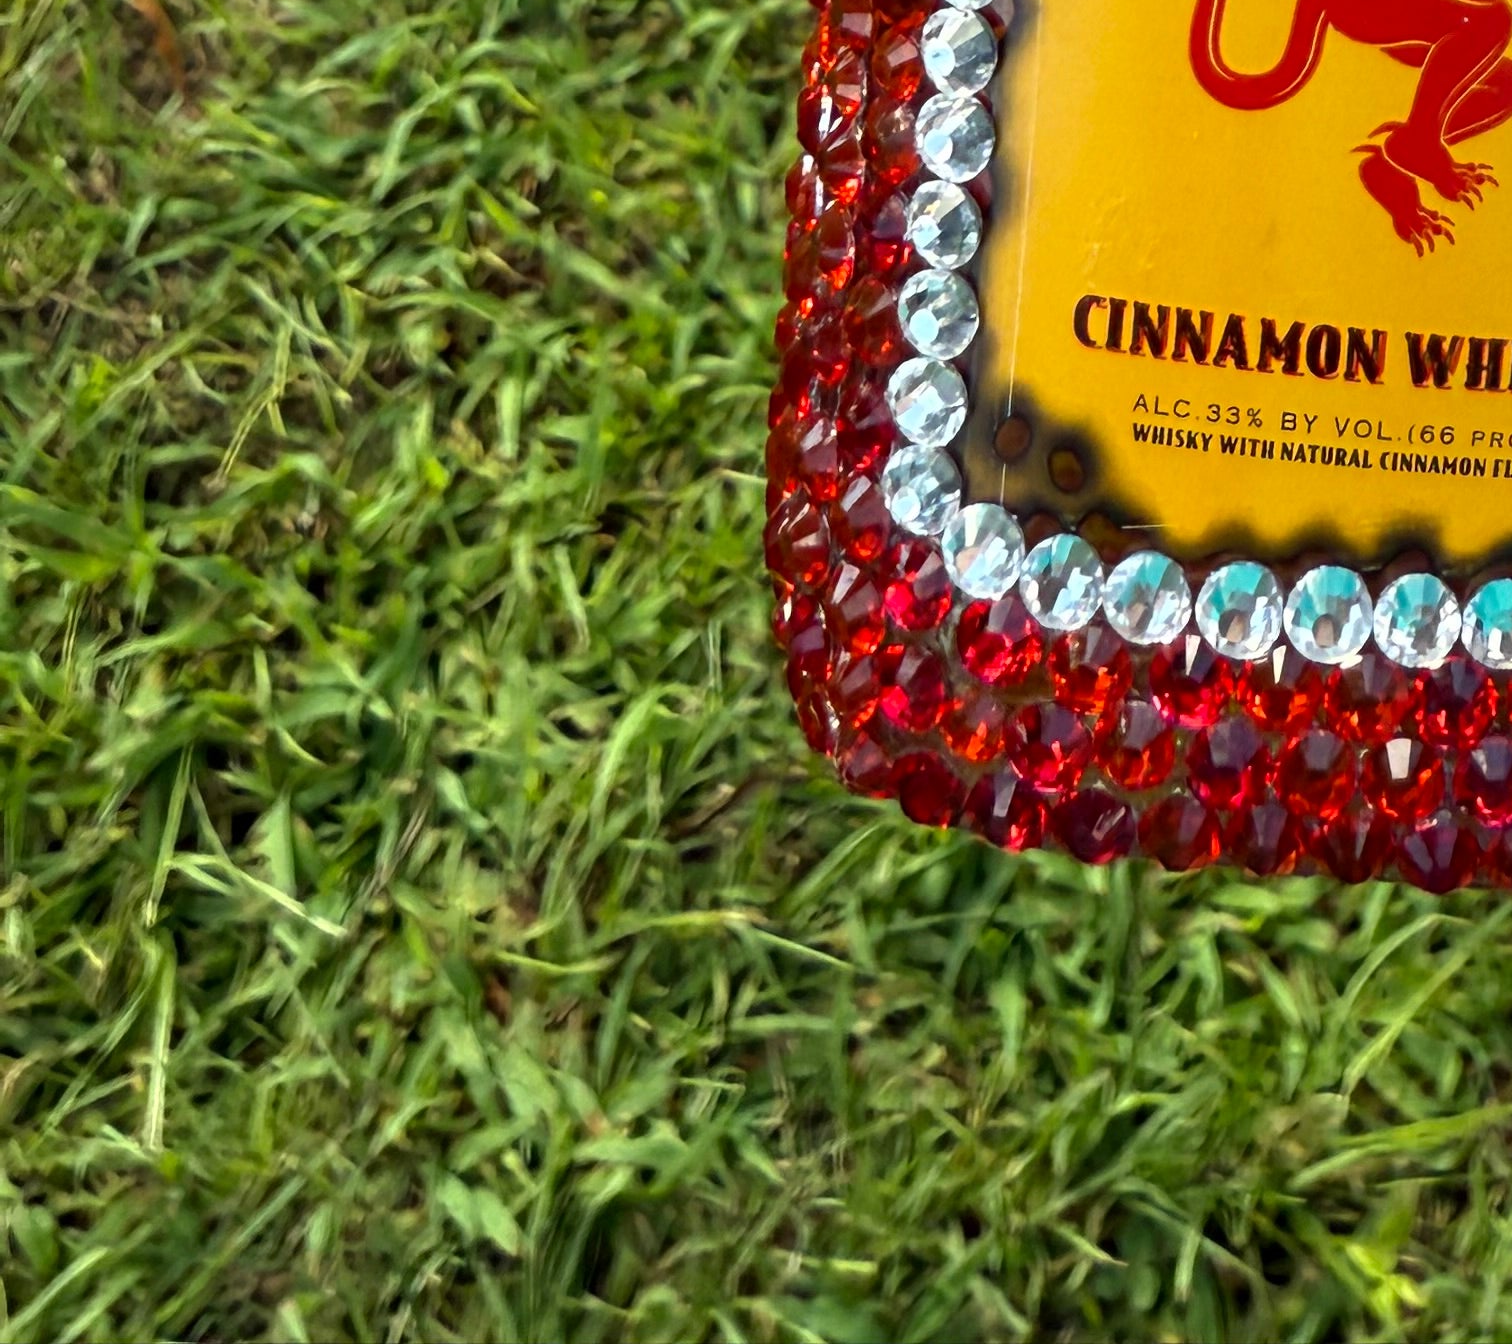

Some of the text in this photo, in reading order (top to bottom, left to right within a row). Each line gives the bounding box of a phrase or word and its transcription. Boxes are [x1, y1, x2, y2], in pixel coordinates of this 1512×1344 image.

[1073, 294, 1386, 384] CINNAMON
[1281, 411, 1318, 434] BY
[1132, 423, 1213, 452] WHISKY
[1220, 434, 1274, 460] WITH
[1280, 442, 1372, 469] NATURAL
[1379, 451, 1487, 478] CINNAMON
